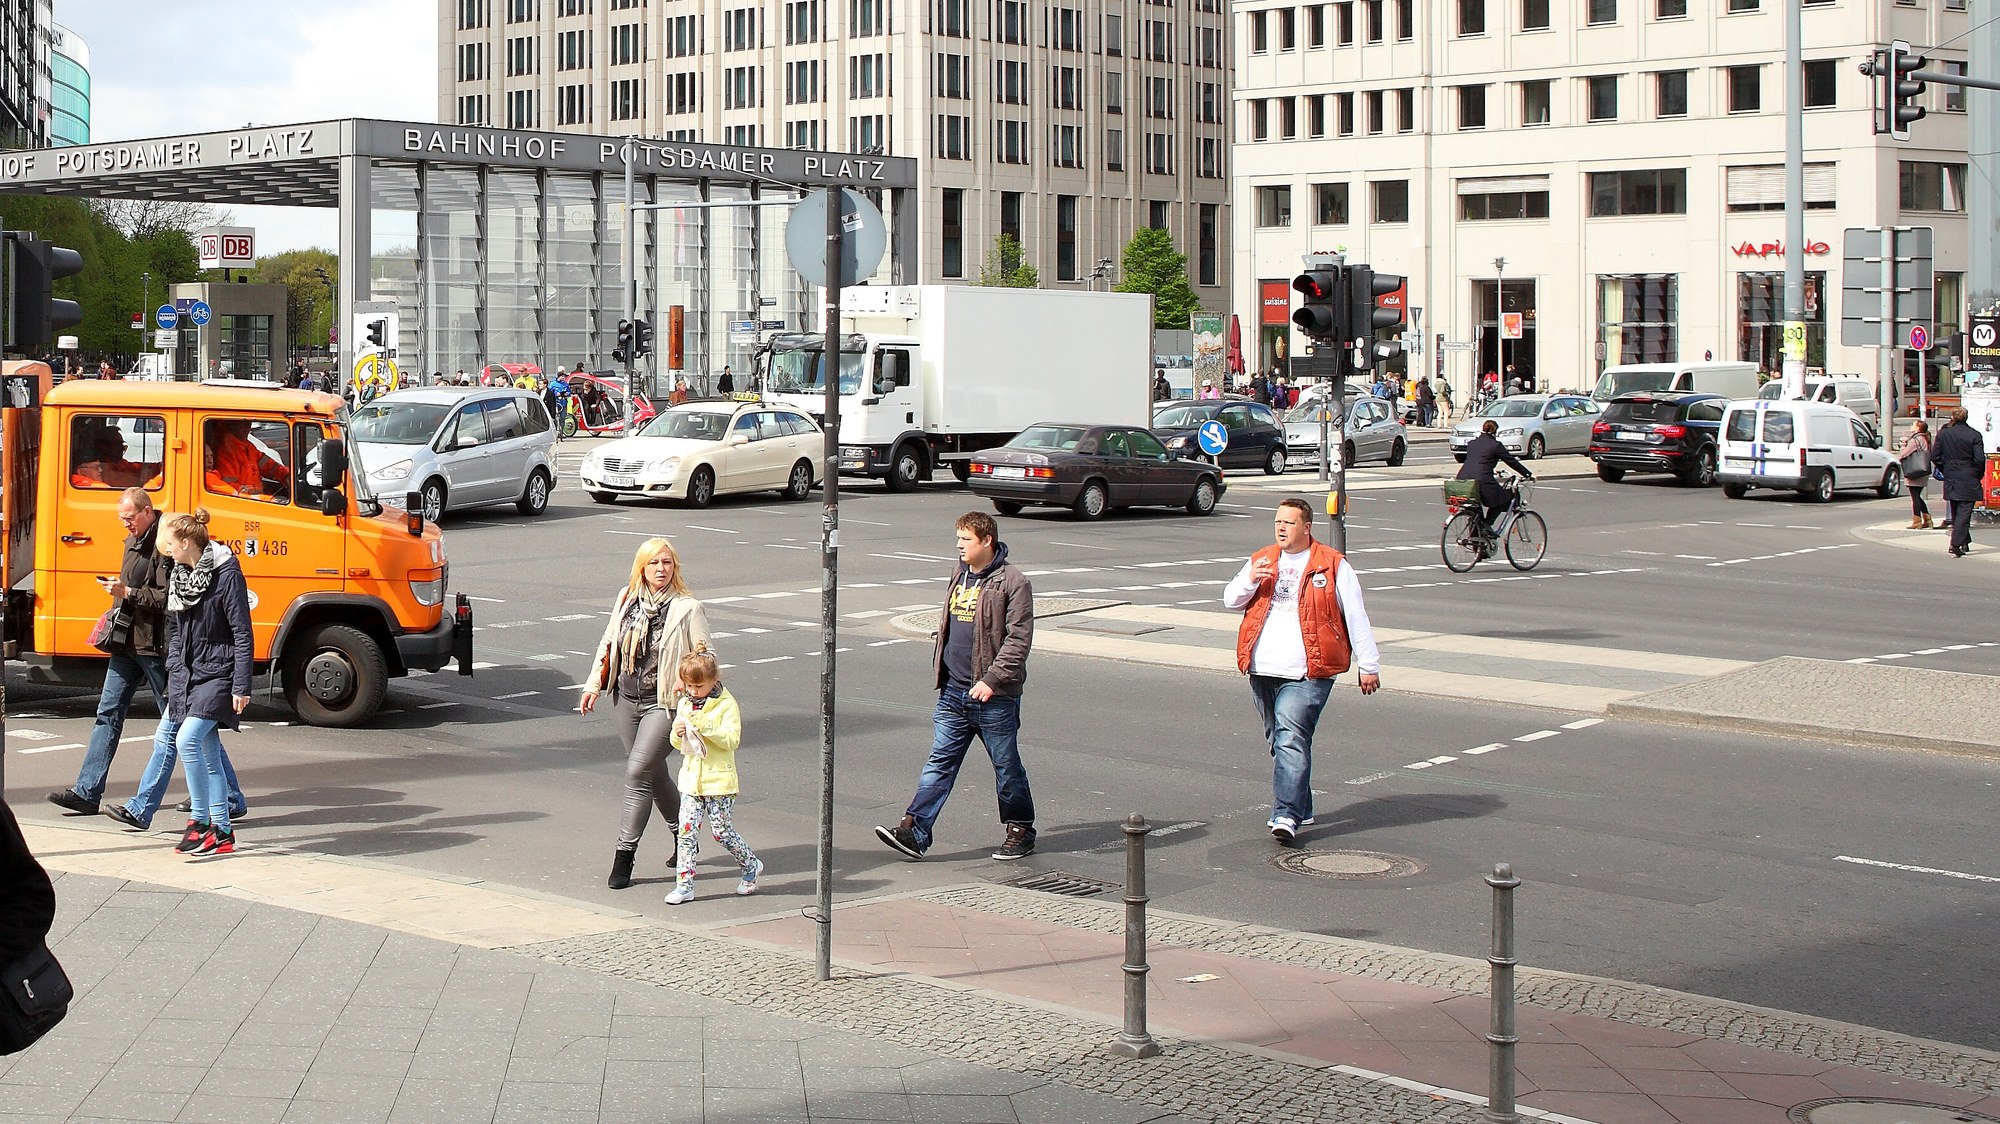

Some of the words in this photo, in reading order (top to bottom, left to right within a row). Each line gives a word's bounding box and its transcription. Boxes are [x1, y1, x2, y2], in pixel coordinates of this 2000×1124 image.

[56, 140, 201, 175] POTSDAMER
[228, 130, 314, 160] PLATZ
[404, 128, 566, 160] BAHNHOF
[600, 142, 775, 174] POTSDAMER
[804, 156, 886, 181] PLATZ
[203, 239, 216, 256] DB
[225, 238, 249, 256] DB
[1976, 328, 1992, 340] M
[1969, 346, 2000, 356] CLOSING
[244, 521, 260, 532] BSR
[262, 540, 288, 556] 436
